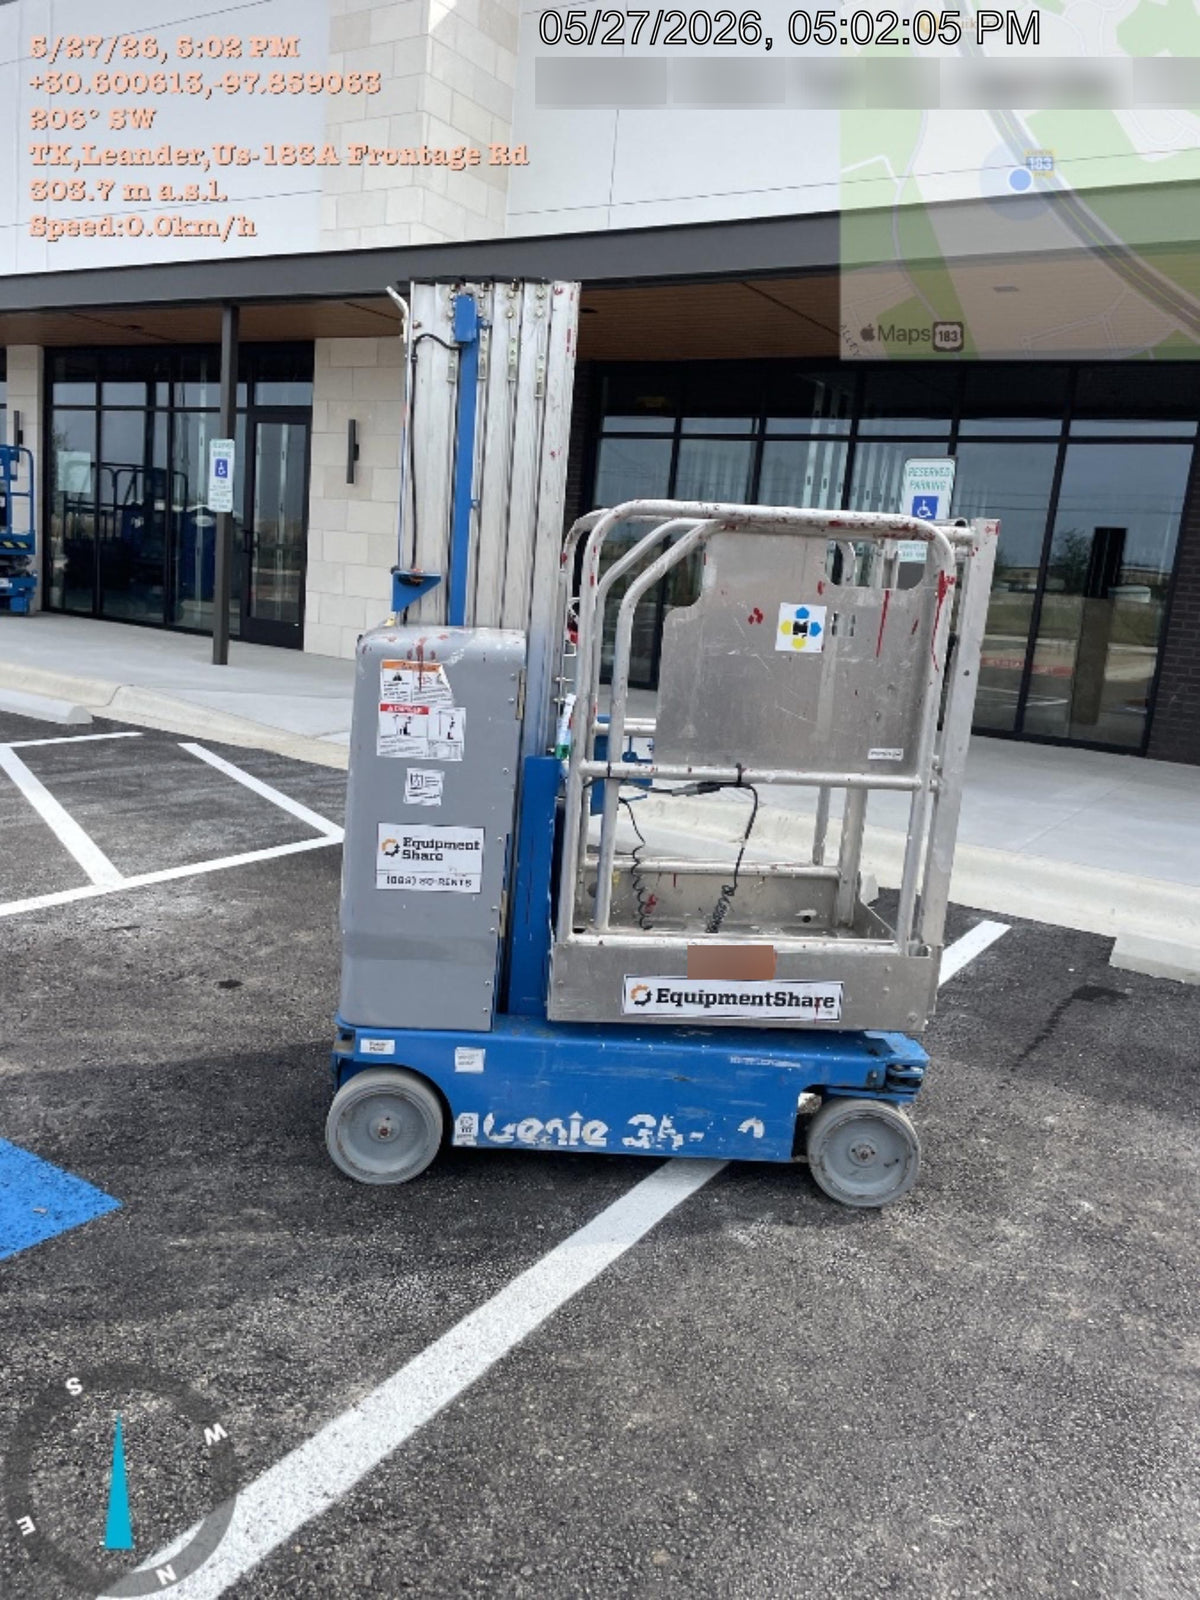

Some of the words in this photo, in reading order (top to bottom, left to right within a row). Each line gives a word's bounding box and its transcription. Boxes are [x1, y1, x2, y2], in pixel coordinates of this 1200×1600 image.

[402, 836, 481, 852] Equipment
[401, 849, 444, 861] Share
[655, 987, 835, 1009] EquipmentShare
